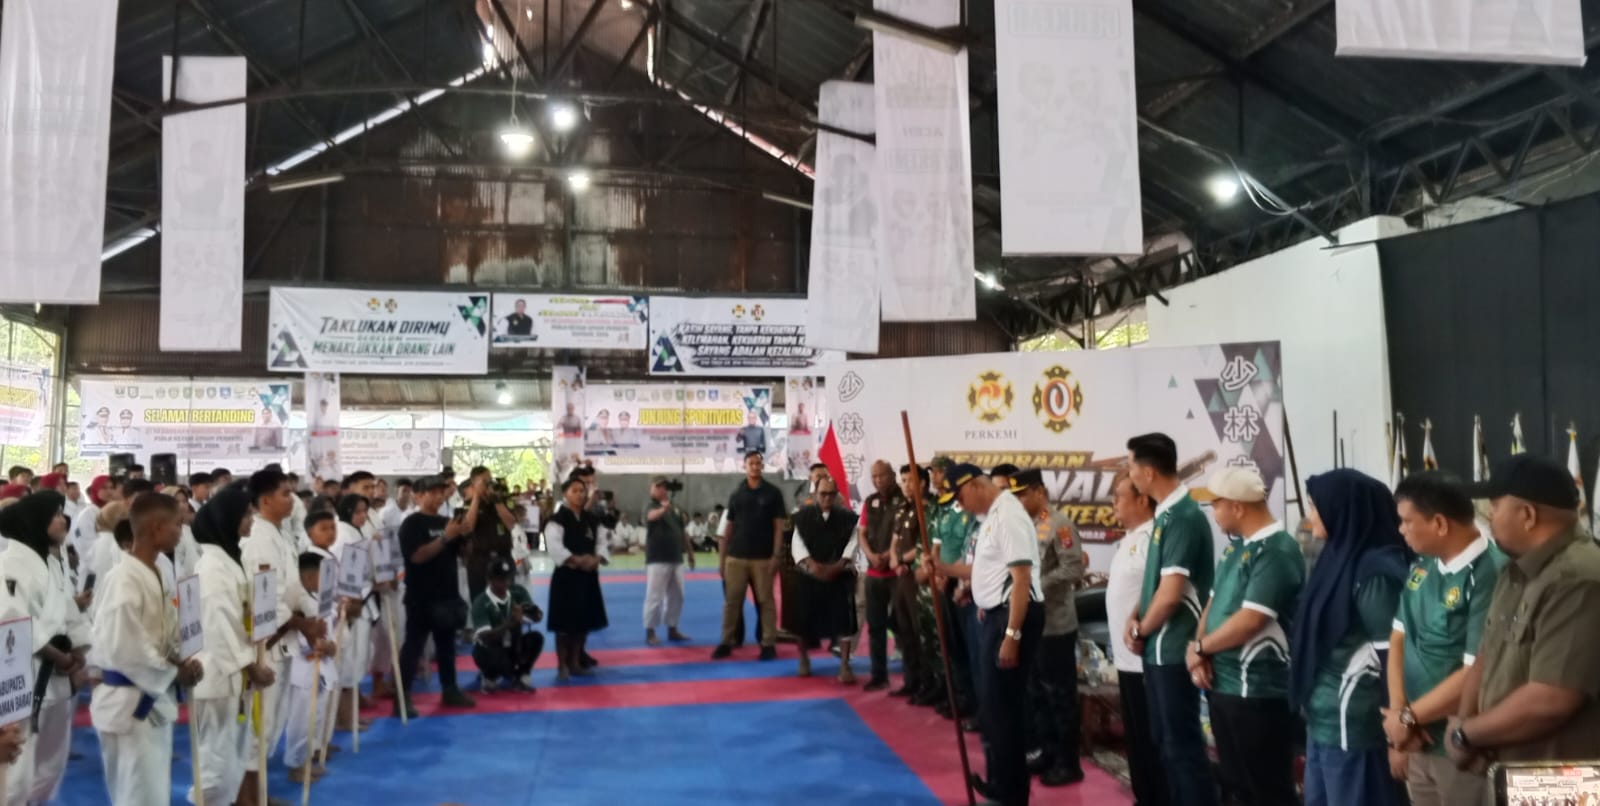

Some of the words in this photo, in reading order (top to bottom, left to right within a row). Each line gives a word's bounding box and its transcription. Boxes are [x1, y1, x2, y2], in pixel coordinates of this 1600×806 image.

[319, 316, 397, 334] TAKLUKAN
[399, 320, 451, 337] DIRIMU
[395, 342, 432, 355] ORANG
[432, 343, 456, 355] LAIN
[144, 408, 190, 423] SELAMAT
[190, 408, 255, 423] BERTANDING
[638, 408, 681, 425] JUNJUNG
[684, 408, 743, 425] SPORTIVITAS
[964, 429, 1018, 441] PERKEMI
